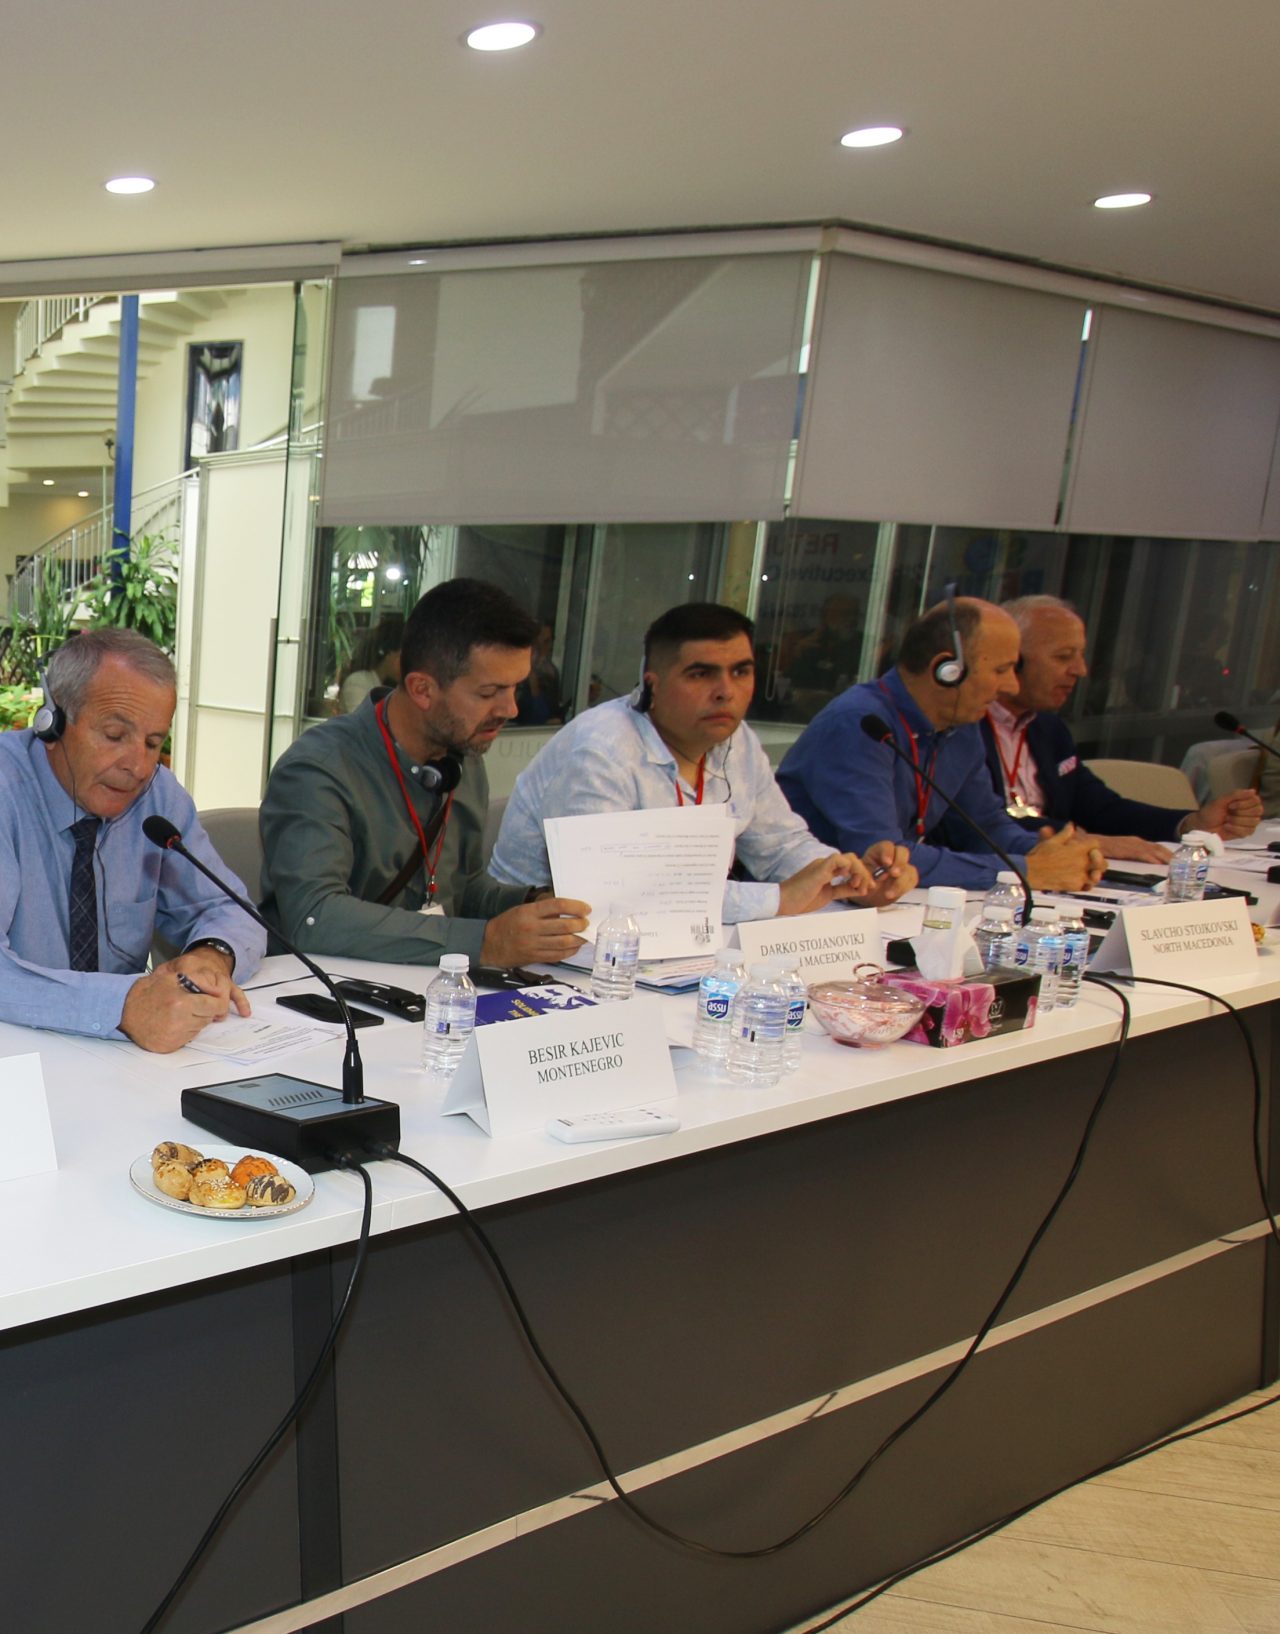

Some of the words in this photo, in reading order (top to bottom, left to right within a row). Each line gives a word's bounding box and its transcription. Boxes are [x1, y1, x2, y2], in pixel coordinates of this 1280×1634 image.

[1141, 926, 1184, 941] SLAVCHO
[760, 941, 798, 957] DARKO
[799, 933, 865, 952] STOJANOVIKJ
[1152, 942, 1182, 954] NORTH
[1183, 936, 1234, 951] MACEDONIA
[804, 950, 861, 967] MACEDONIA
[528, 1043, 568, 1065] BESIR
[570, 1032, 625, 1057] KAJEVIC
[537, 1054, 624, 1084] MONTENEGRO
